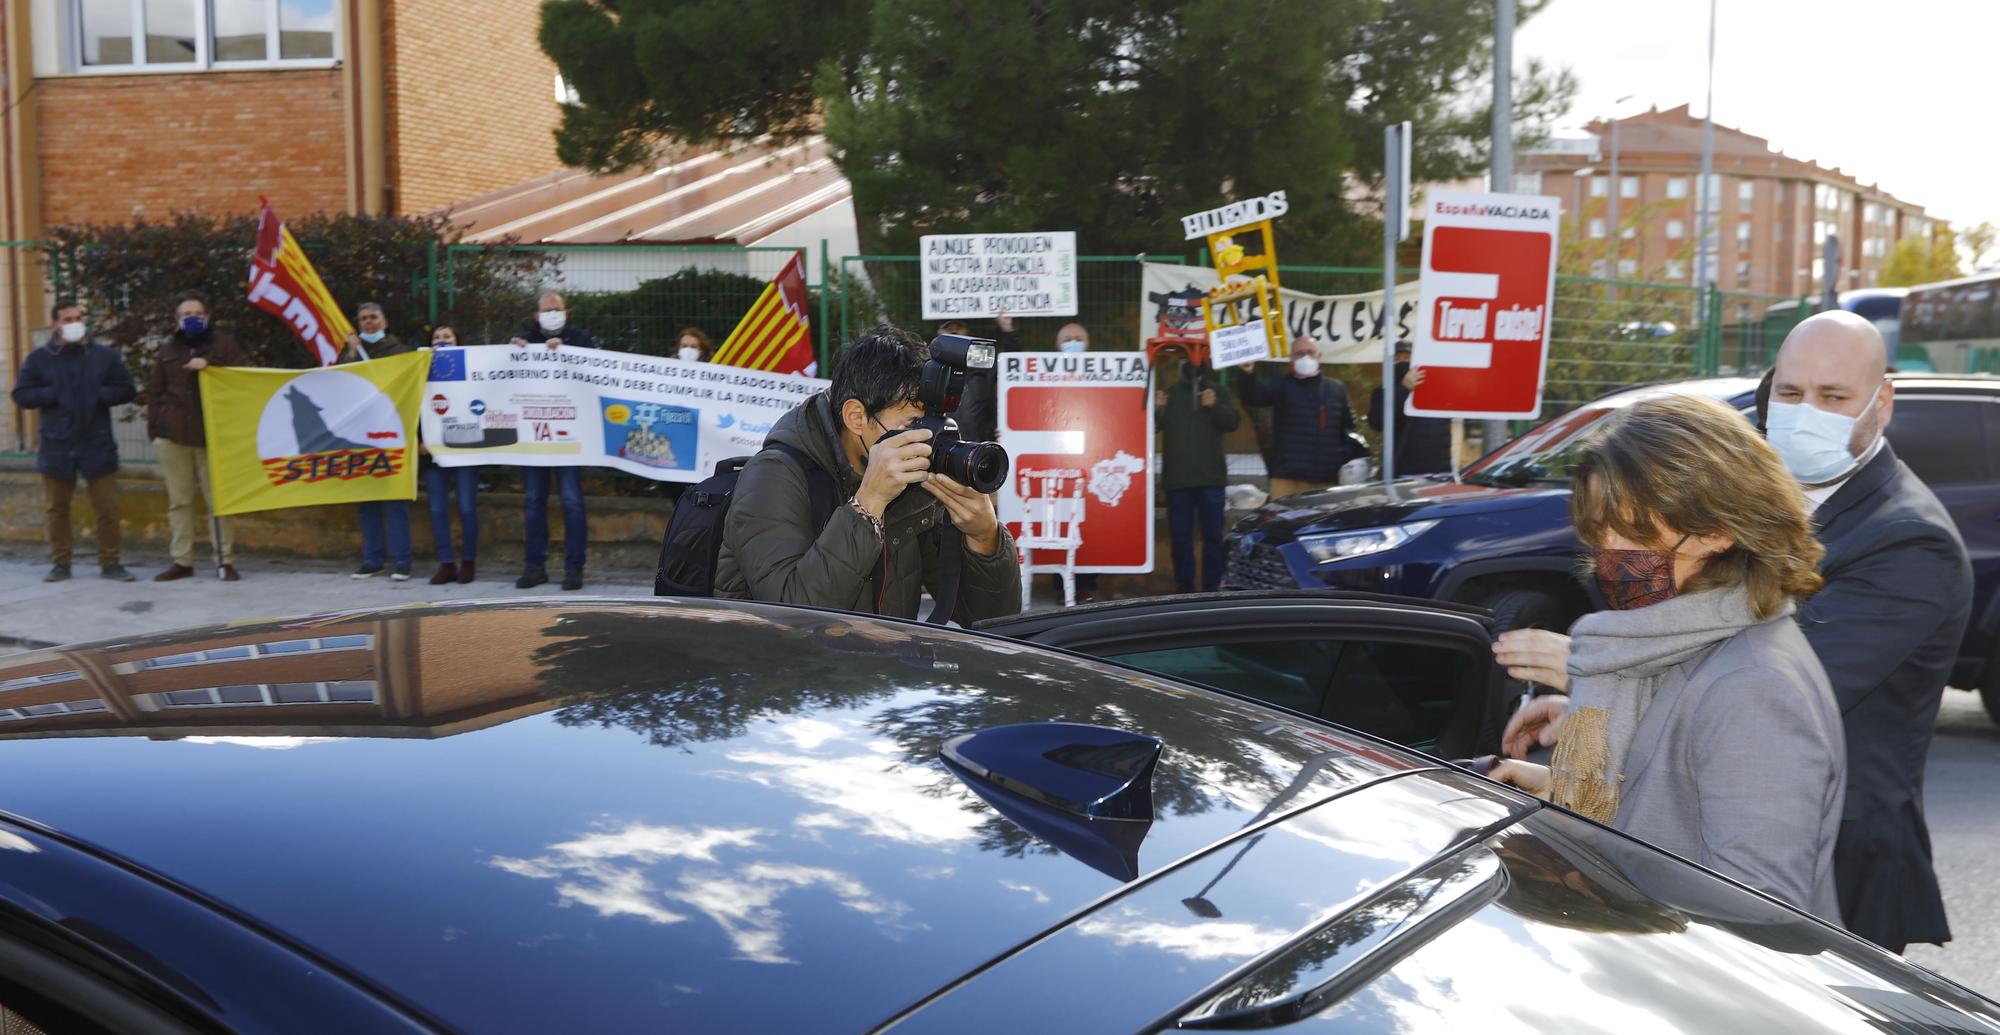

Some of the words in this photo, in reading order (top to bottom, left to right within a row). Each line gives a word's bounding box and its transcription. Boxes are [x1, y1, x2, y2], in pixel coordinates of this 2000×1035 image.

[929, 238, 976, 255] AUNQUE
[984, 236, 1053, 254] PROVOQUEN
[929, 257, 981, 273] NUESTRA
[930, 278, 945, 293] NO
[1014, 277, 1039, 292] CON
[930, 297, 982, 313] NUESTRA
[989, 294, 1052, 312] EXISTENCIA
[510, 352, 529, 362] NO
[560, 353, 618, 370] DESPIDOS
[621, 362, 678, 377] ILEGALES
[681, 368, 696, 380] DE
[700, 369, 775, 390] EMPLEADOS
[1006, 357, 1145, 373] REVUELTA
[472, 371, 485, 381] EL
[488, 370, 549, 380] GOBIERNO
[553, 370, 569, 380] DE
[572, 371, 620, 388] ARAGÓN
[623, 379, 654, 392] DEBE
[657, 383, 714, 400] CUMPLIR
[717, 391, 733, 401] LA
[1006, 373, 1020, 381] de
[1024, 373, 1034, 381] la
[532, 422, 552, 441] YA
[283, 452, 393, 482] STEPA
